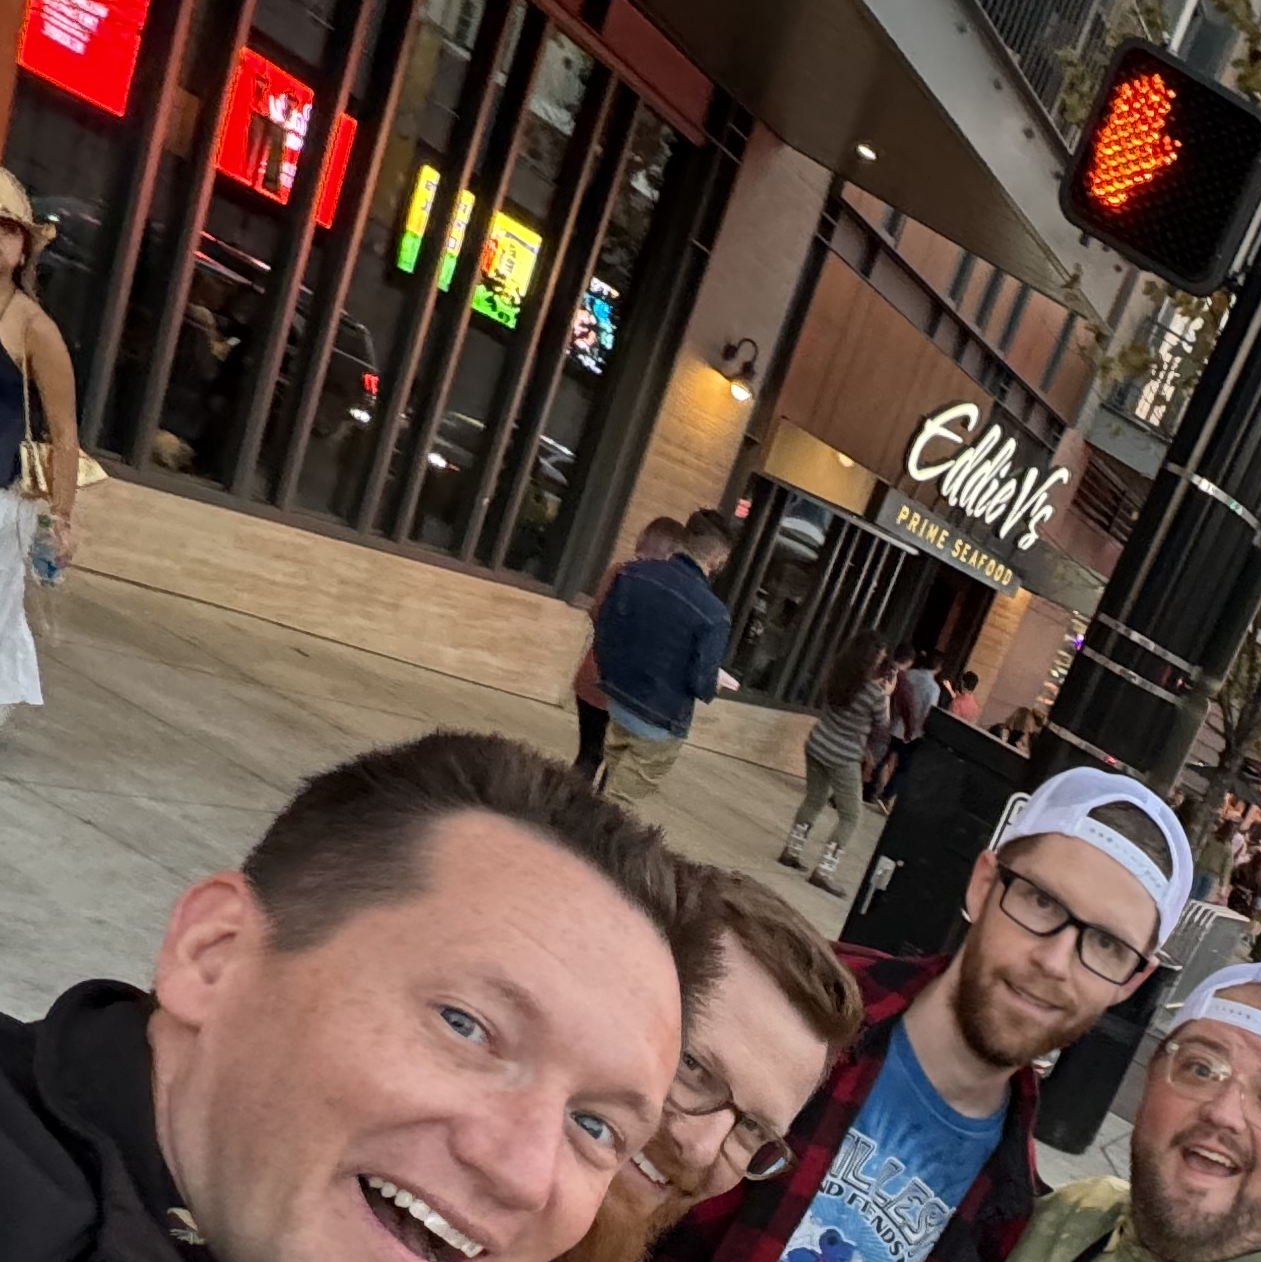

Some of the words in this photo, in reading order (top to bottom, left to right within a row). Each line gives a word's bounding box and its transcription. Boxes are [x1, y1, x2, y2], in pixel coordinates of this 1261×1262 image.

[907, 402, 1018, 525] Eddie
[896, 505, 950, 550] PRIME
[950, 538, 1014, 587] SEAFOOD
